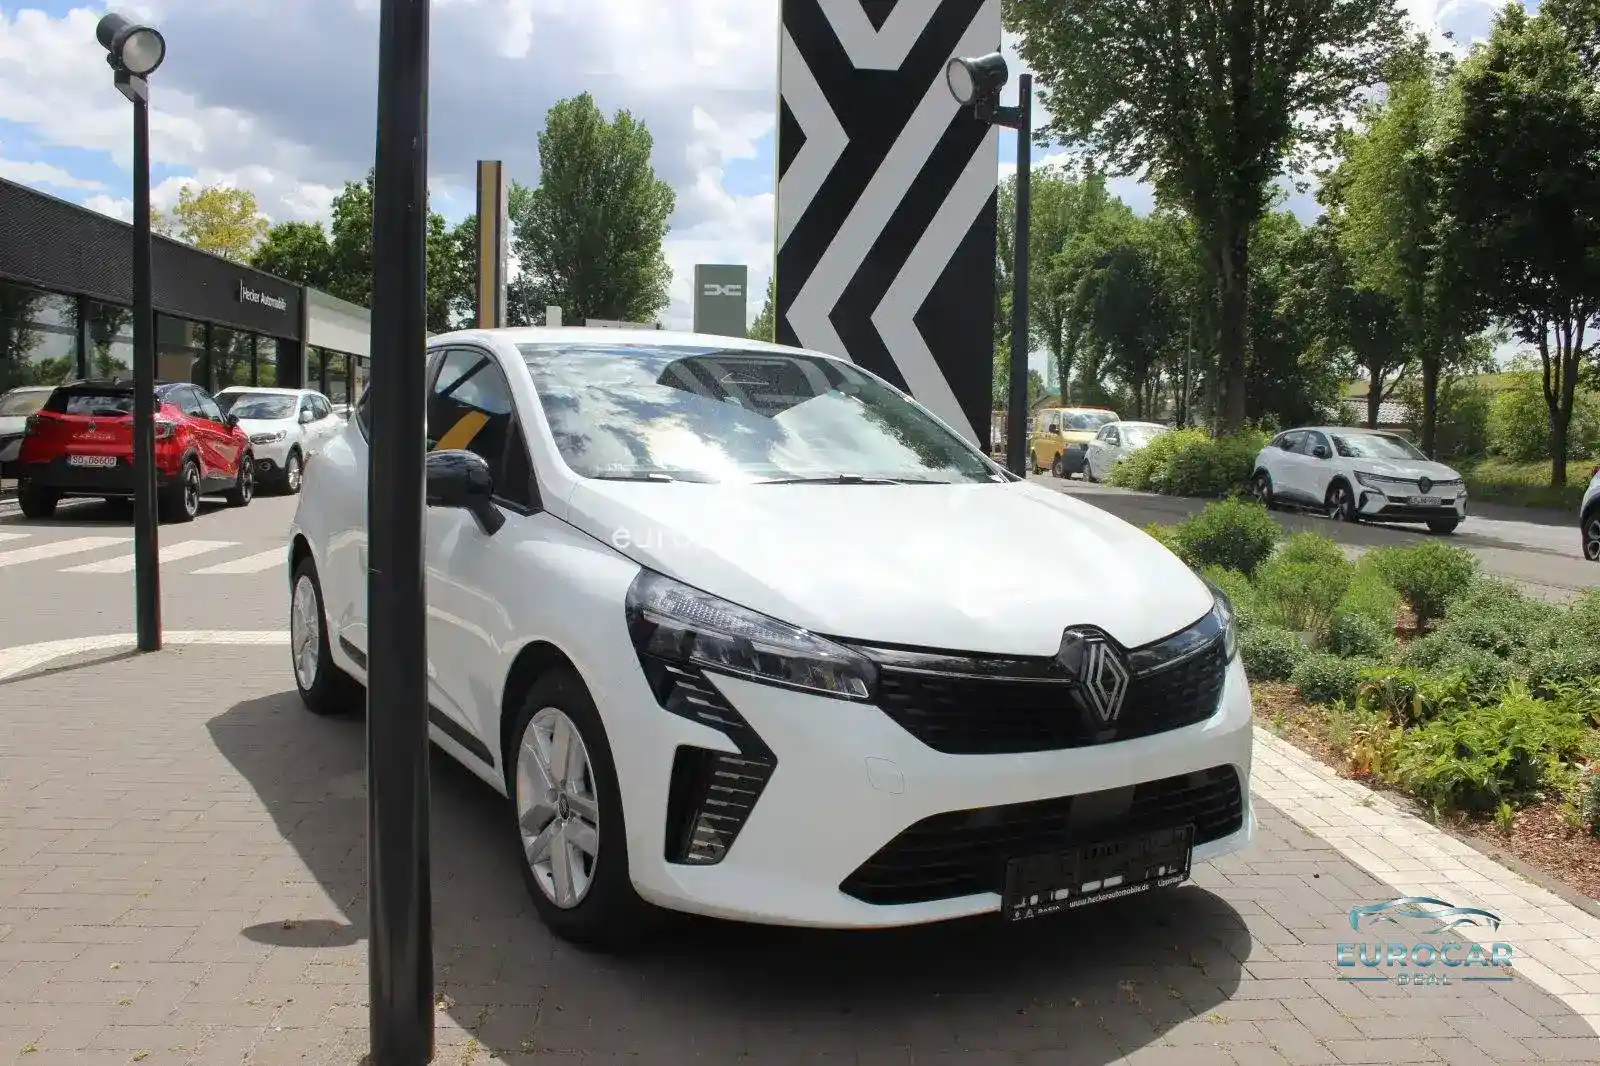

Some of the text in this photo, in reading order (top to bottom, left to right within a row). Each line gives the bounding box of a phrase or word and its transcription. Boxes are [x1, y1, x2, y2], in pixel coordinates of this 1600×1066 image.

[243, 286, 287, 310] Hecker Automobile
[1069, 883, 1149, 908] www.heckerautomobile.de
